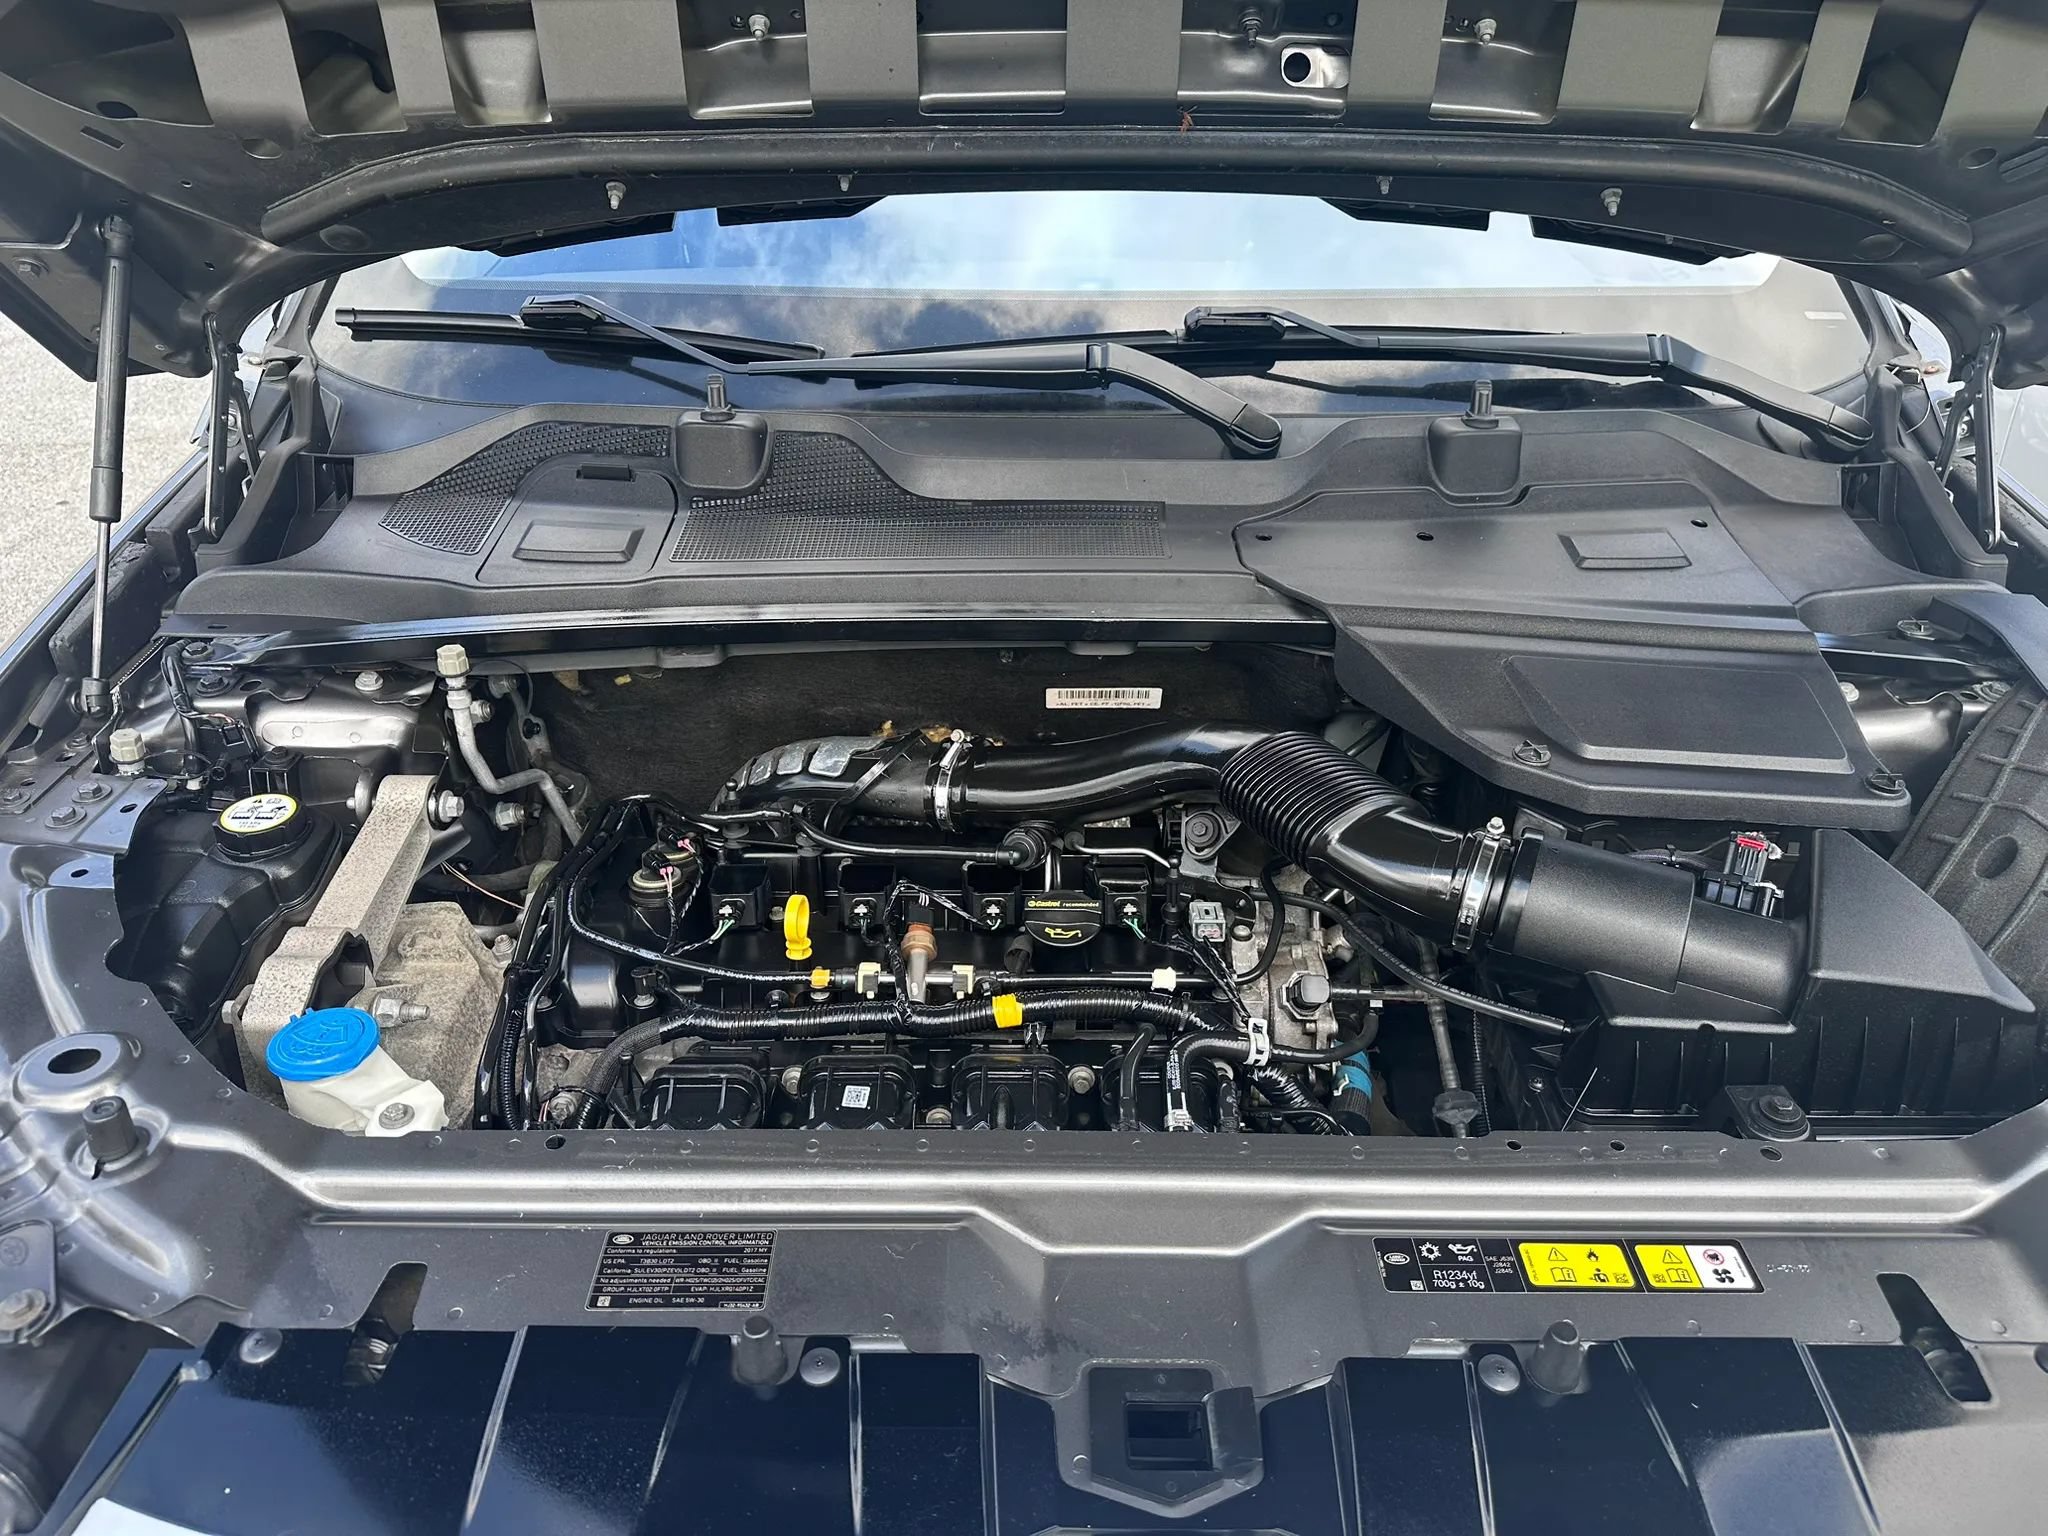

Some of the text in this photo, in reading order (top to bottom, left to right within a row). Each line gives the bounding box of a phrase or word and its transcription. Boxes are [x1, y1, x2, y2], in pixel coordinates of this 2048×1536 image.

[640, 1233, 676, 1241] JAGUAR
[737, 1232, 773, 1240] LIMITED
[1433, 1270, 1478, 1280] R1234yf
[1432, 1280, 1457, 1289] 700g
[1467, 1280, 1485, 1289] 10g
